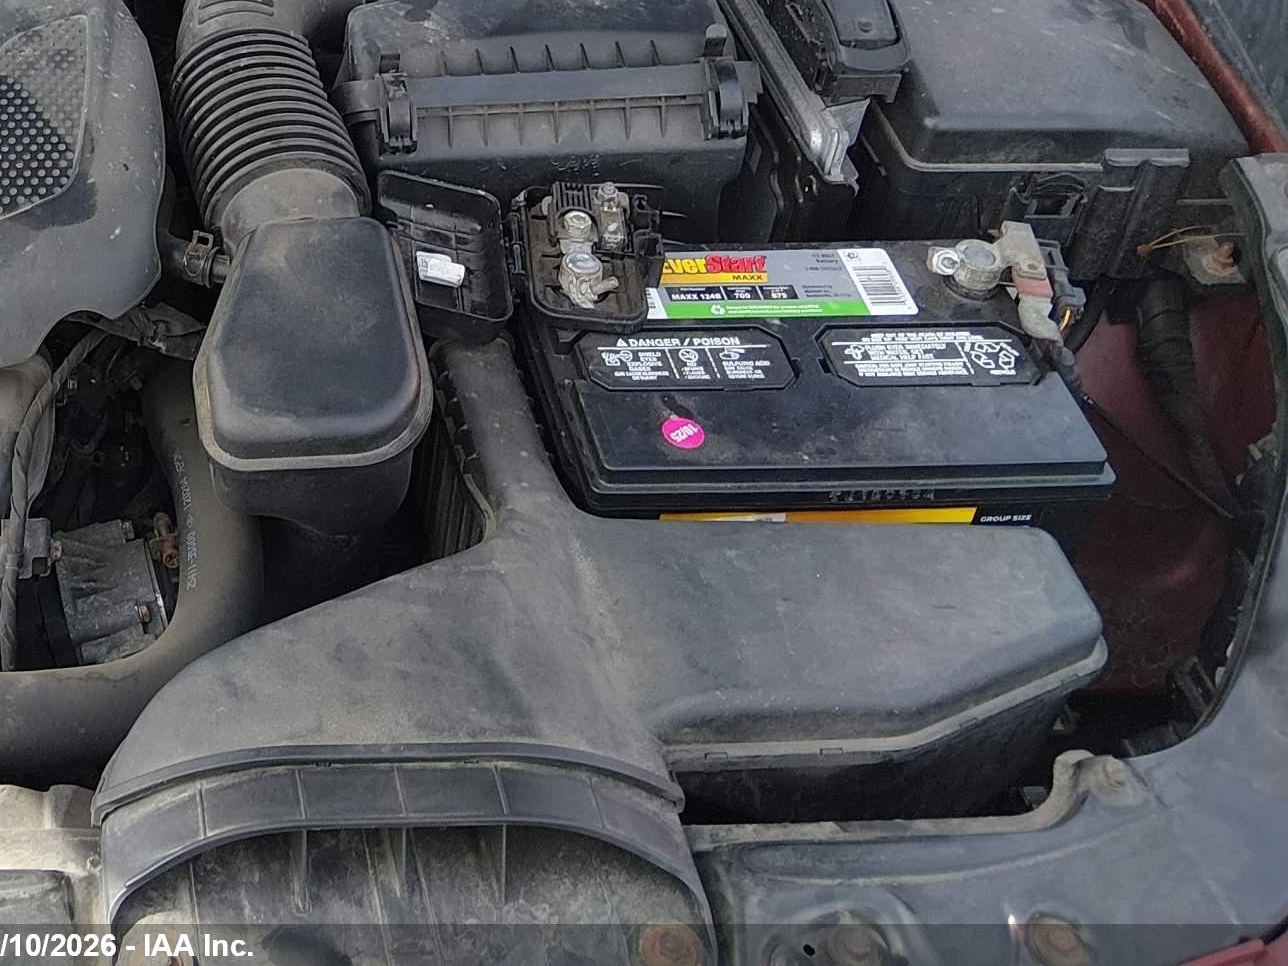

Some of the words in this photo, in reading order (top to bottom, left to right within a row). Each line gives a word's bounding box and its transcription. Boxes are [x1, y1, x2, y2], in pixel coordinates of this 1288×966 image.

[629, 338, 681, 347] DANGER
[692, 337, 741, 346] POISON
[669, 423, 699, 443] 10/25
[980, 514, 1011, 523] GROUP
[1012, 514, 1032, 522] SIZE
